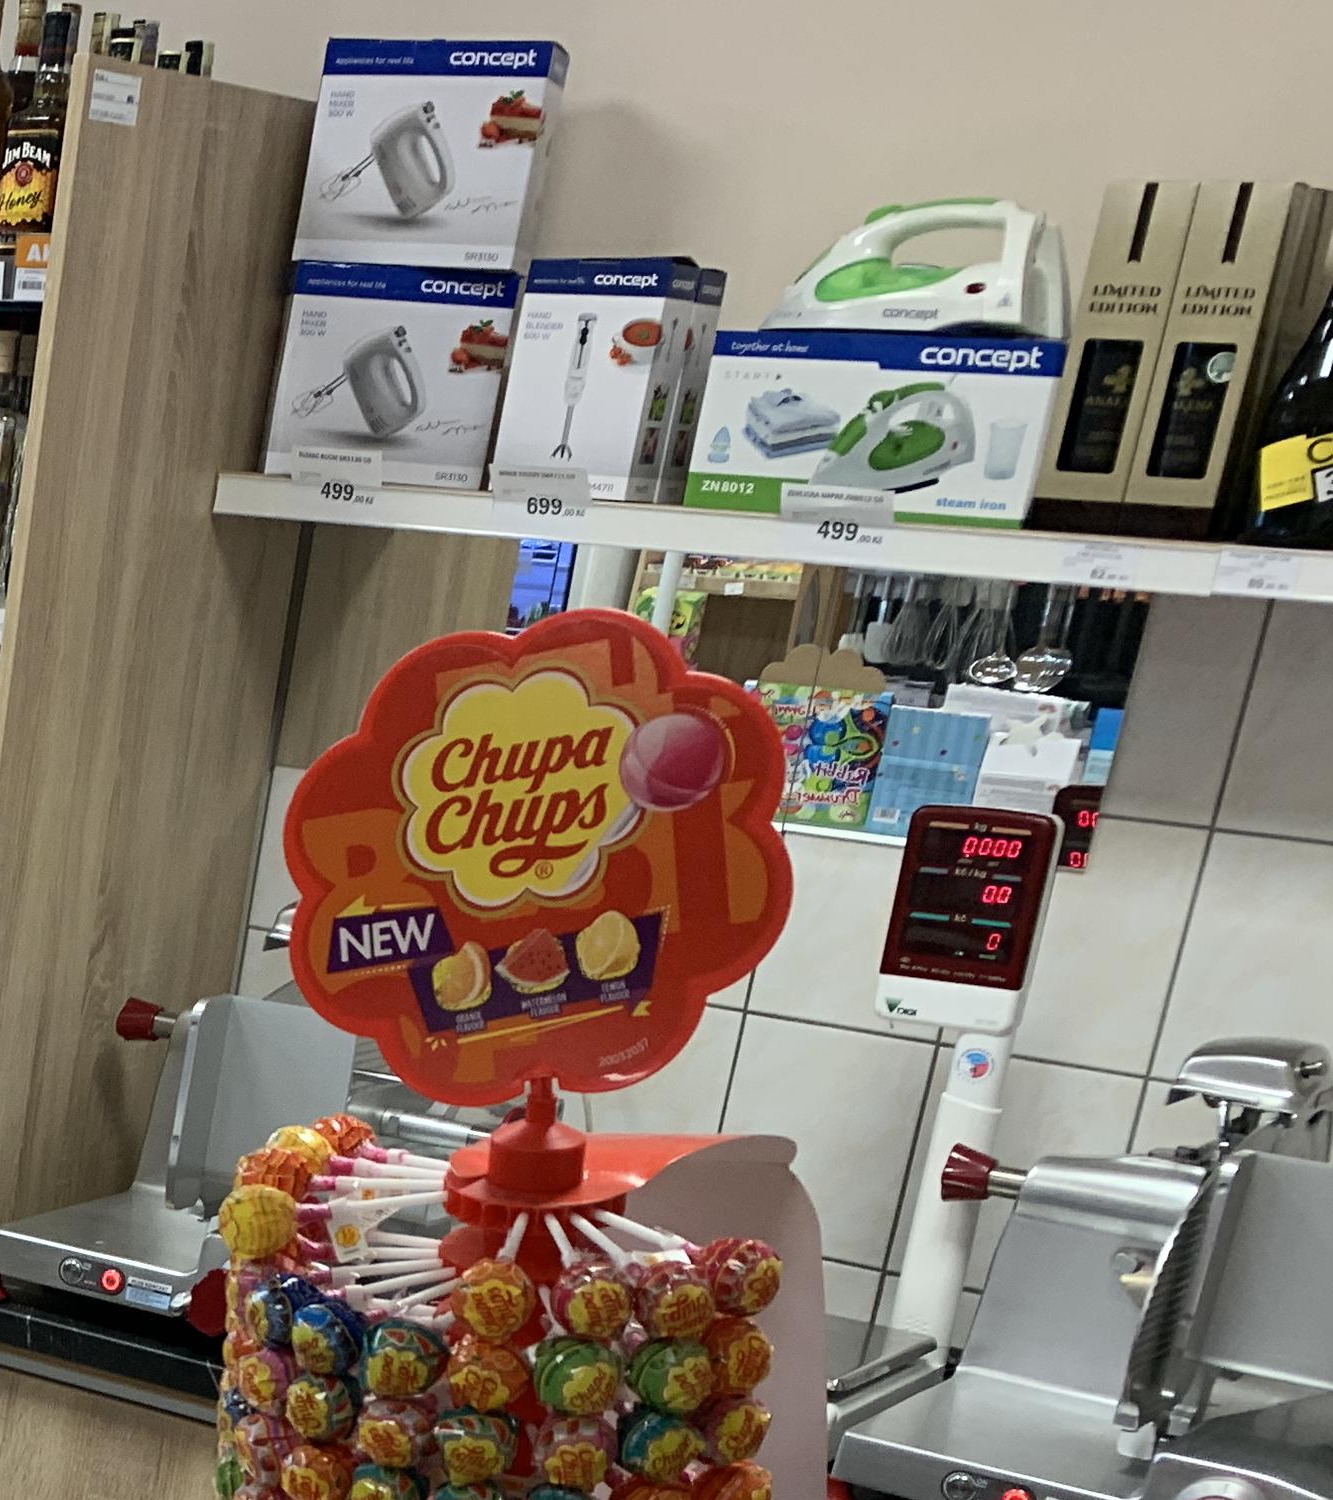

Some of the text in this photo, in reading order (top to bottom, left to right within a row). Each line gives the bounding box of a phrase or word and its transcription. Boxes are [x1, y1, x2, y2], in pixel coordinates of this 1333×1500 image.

[450, 49, 537, 69] concept
[2, 141, 52, 164] JIM BEAM
[420, 279, 505, 299] concept
[593, 273, 658, 289] concept
[1092, 284, 1162, 298] LIMITED
[1185, 285, 1256, 299] LIMITED
[882, 308, 939, 321] concept
[1088, 301, 1158, 316] EDITION
[1181, 303, 1253, 317] EDITION
[920, 346, 1043, 373] concept
[321, 481, 355, 501] 499
[527, 497, 562, 515] 699
[936, 497, 1007, 512] steam iron
[817, 521, 858, 541] 499
[431, 726, 615, 793] Chupa
[425, 783, 609, 879] Chups
[338, 913, 436, 964] NEW
[986, 933, 1002, 951] 0
[897, 1007, 917, 1017] DIGI
